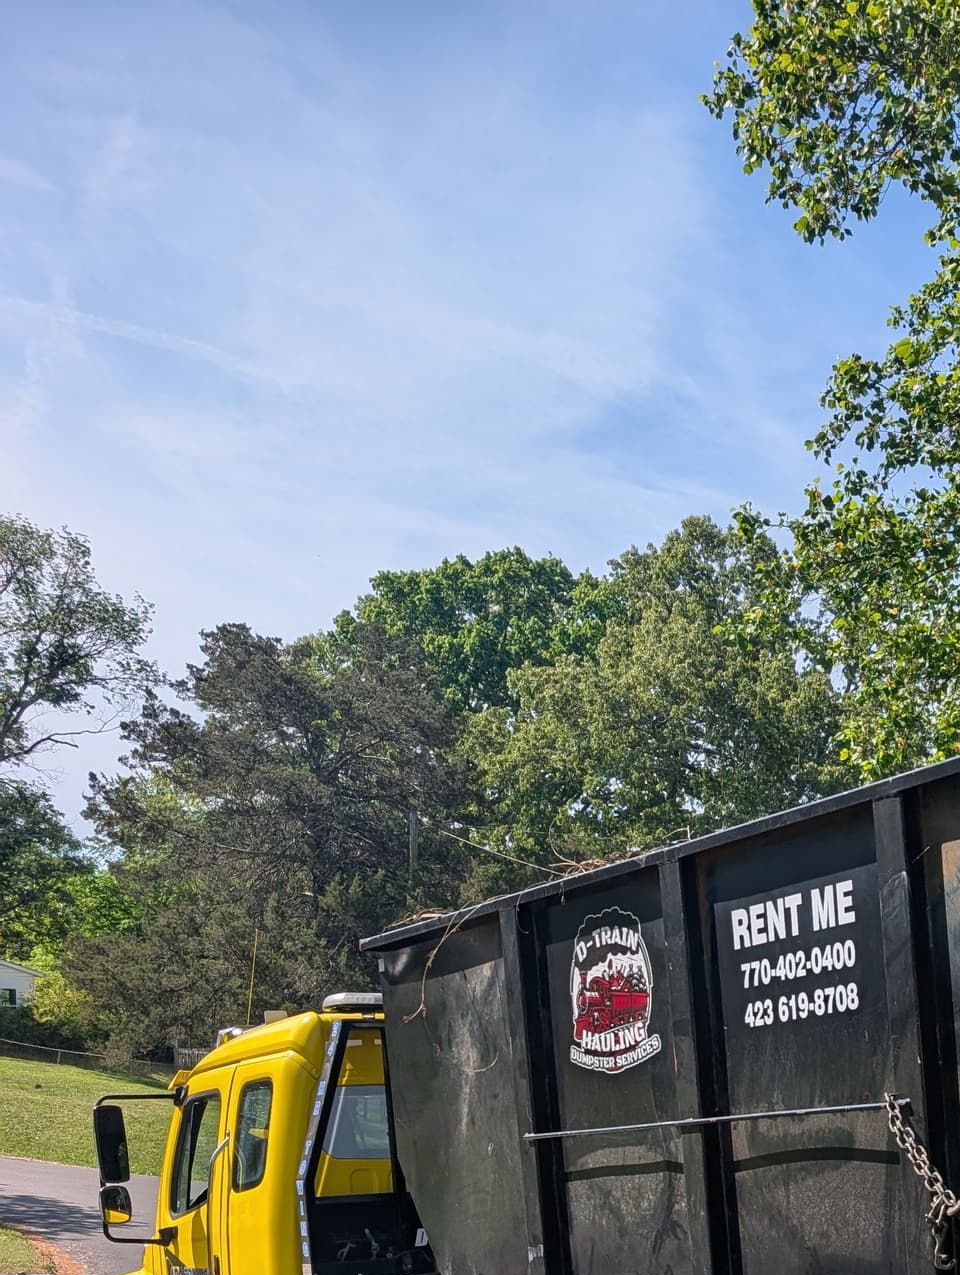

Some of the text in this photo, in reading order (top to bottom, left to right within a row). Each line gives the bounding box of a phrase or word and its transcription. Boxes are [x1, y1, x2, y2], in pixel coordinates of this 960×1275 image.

[731, 880, 856, 950] RENT ME
[576, 925, 640, 962] D-TRAIN
[741, 940, 856, 989] 770-402-0400
[744, 982, 859, 1028] 423 619-8708
[571, 1035, 660, 1069] DUMPSTER SERVICES
[582, 1023, 646, 1052] HAULING
